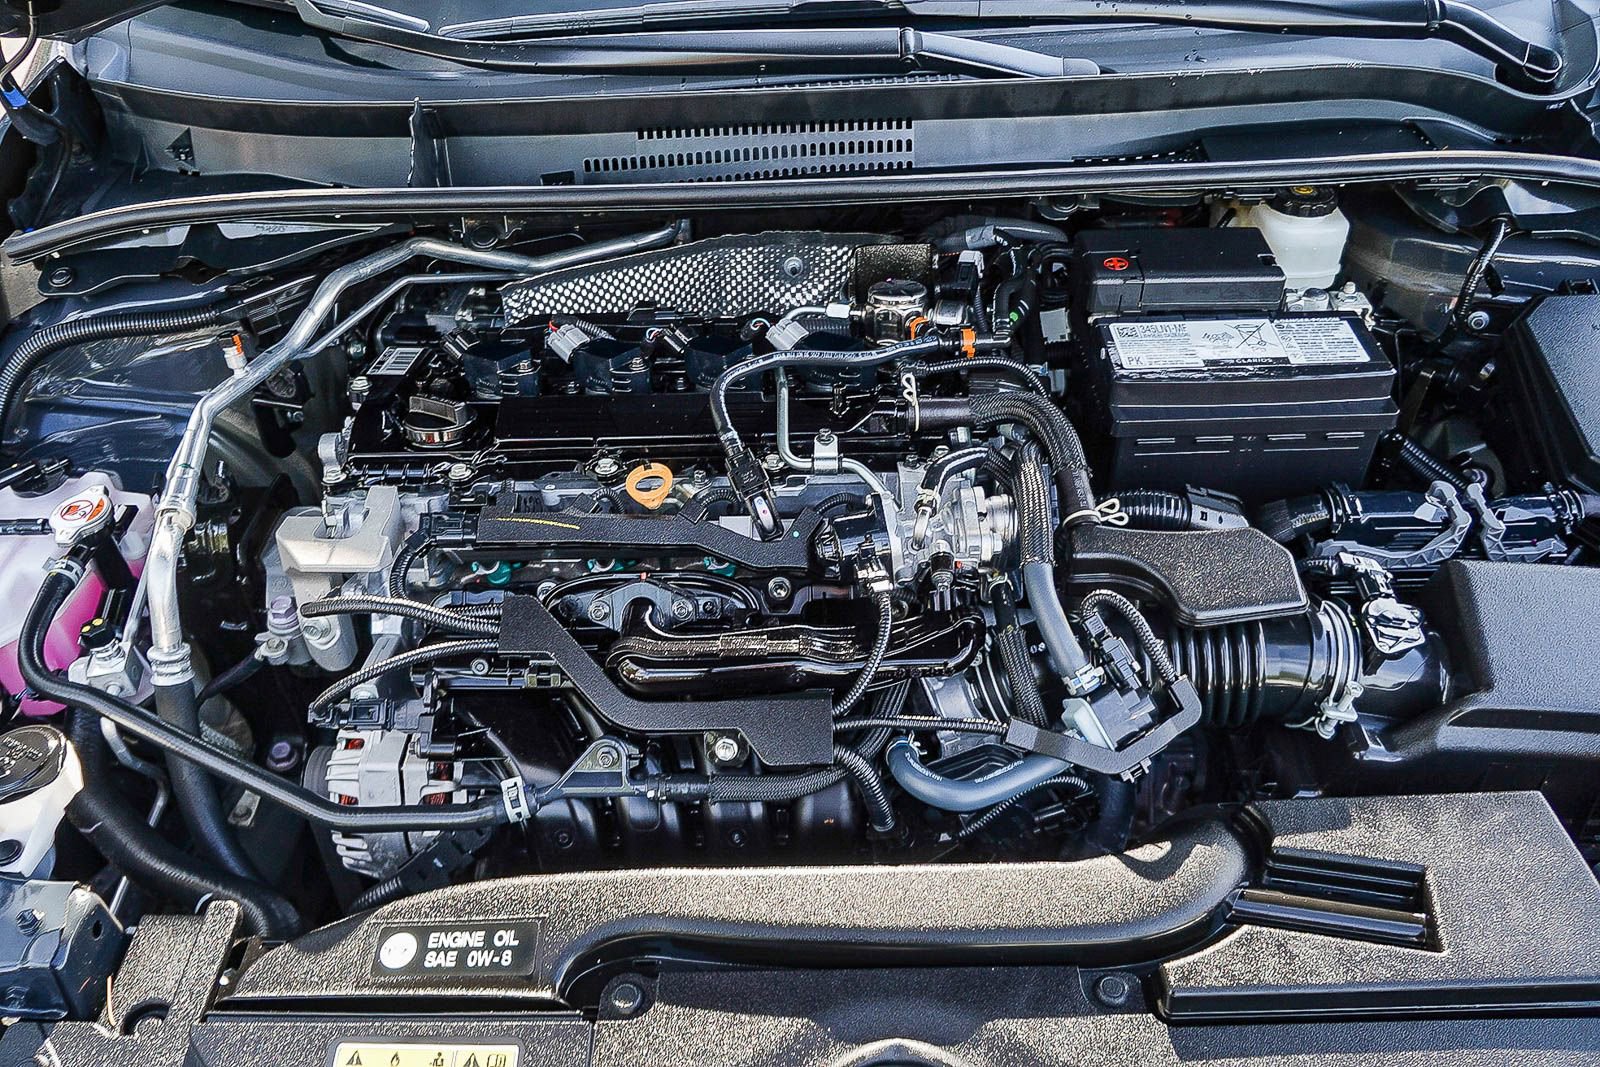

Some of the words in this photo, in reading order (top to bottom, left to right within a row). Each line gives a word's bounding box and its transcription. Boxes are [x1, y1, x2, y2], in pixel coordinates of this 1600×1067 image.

[1127, 356, 1143, 365] PK
[427, 930, 486, 949] ENGINE
[493, 929, 520, 947] OIL
[423, 950, 458, 968] SAE
[466, 949, 513, 968] 0W-8
